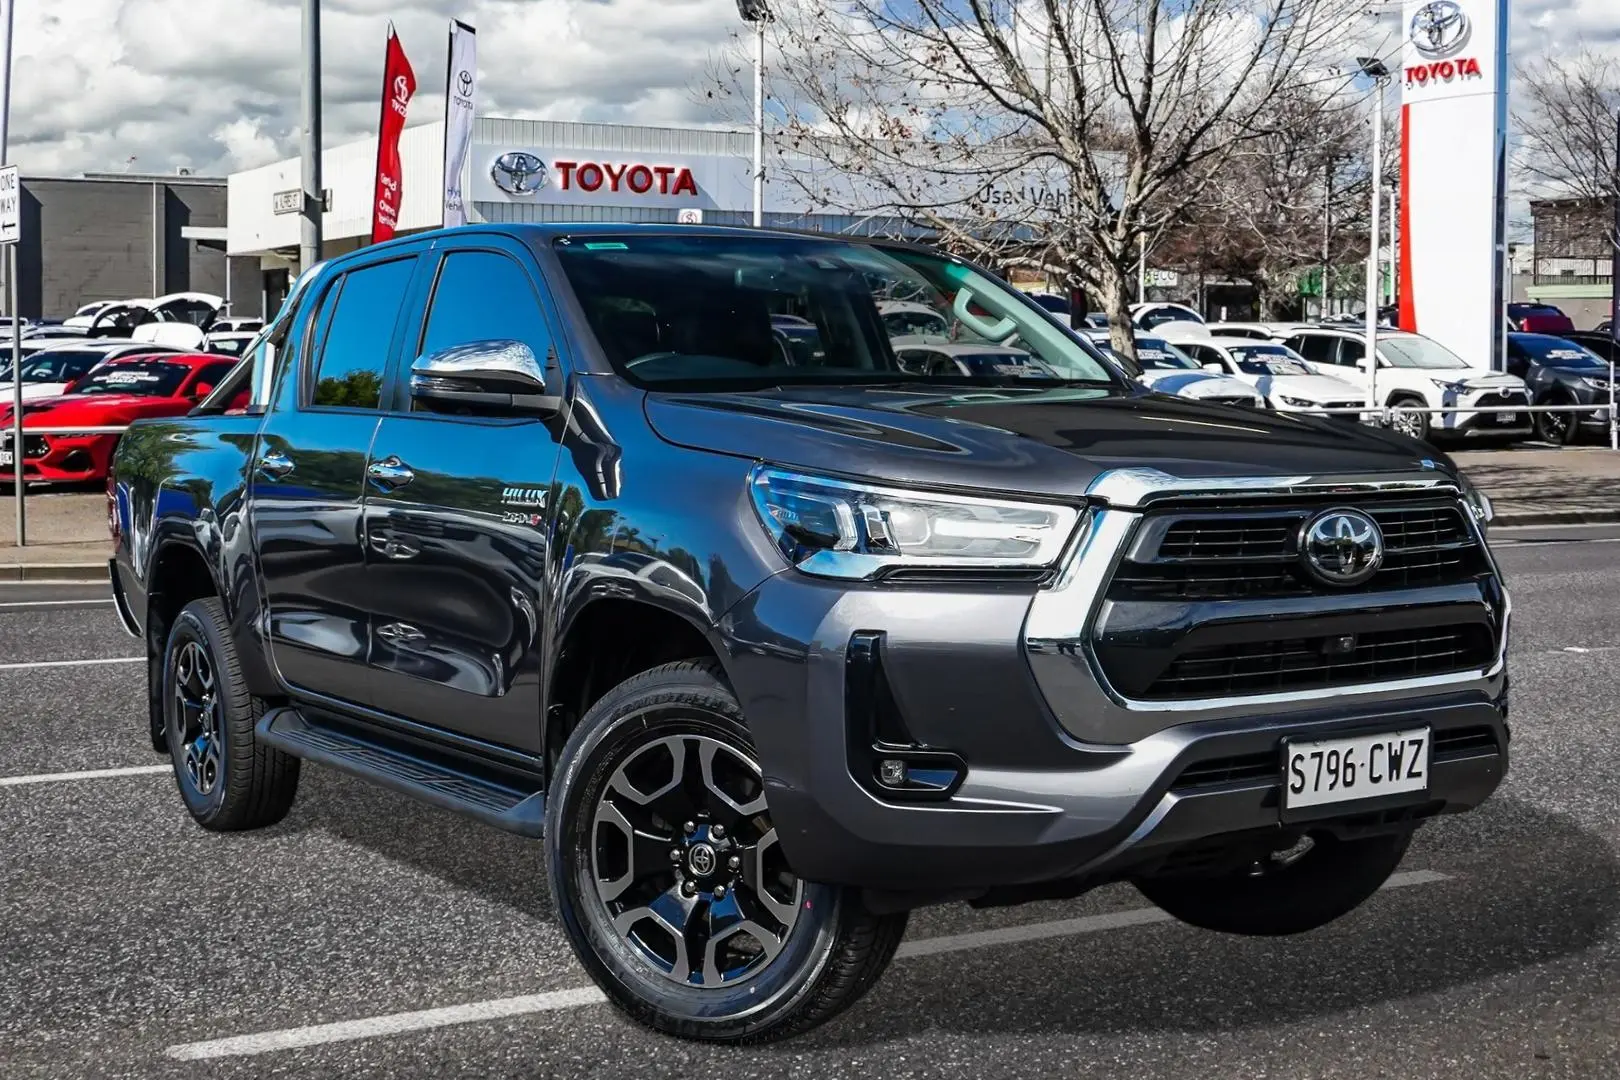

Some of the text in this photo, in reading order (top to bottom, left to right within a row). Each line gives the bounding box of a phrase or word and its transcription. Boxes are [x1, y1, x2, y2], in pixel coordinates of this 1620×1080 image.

[1404, 58, 1480, 83] TOYOTA
[555, 161, 698, 196] TOYOTA
[0, 196, 16, 213] WAY
[501, 487, 548, 508] HILUX
